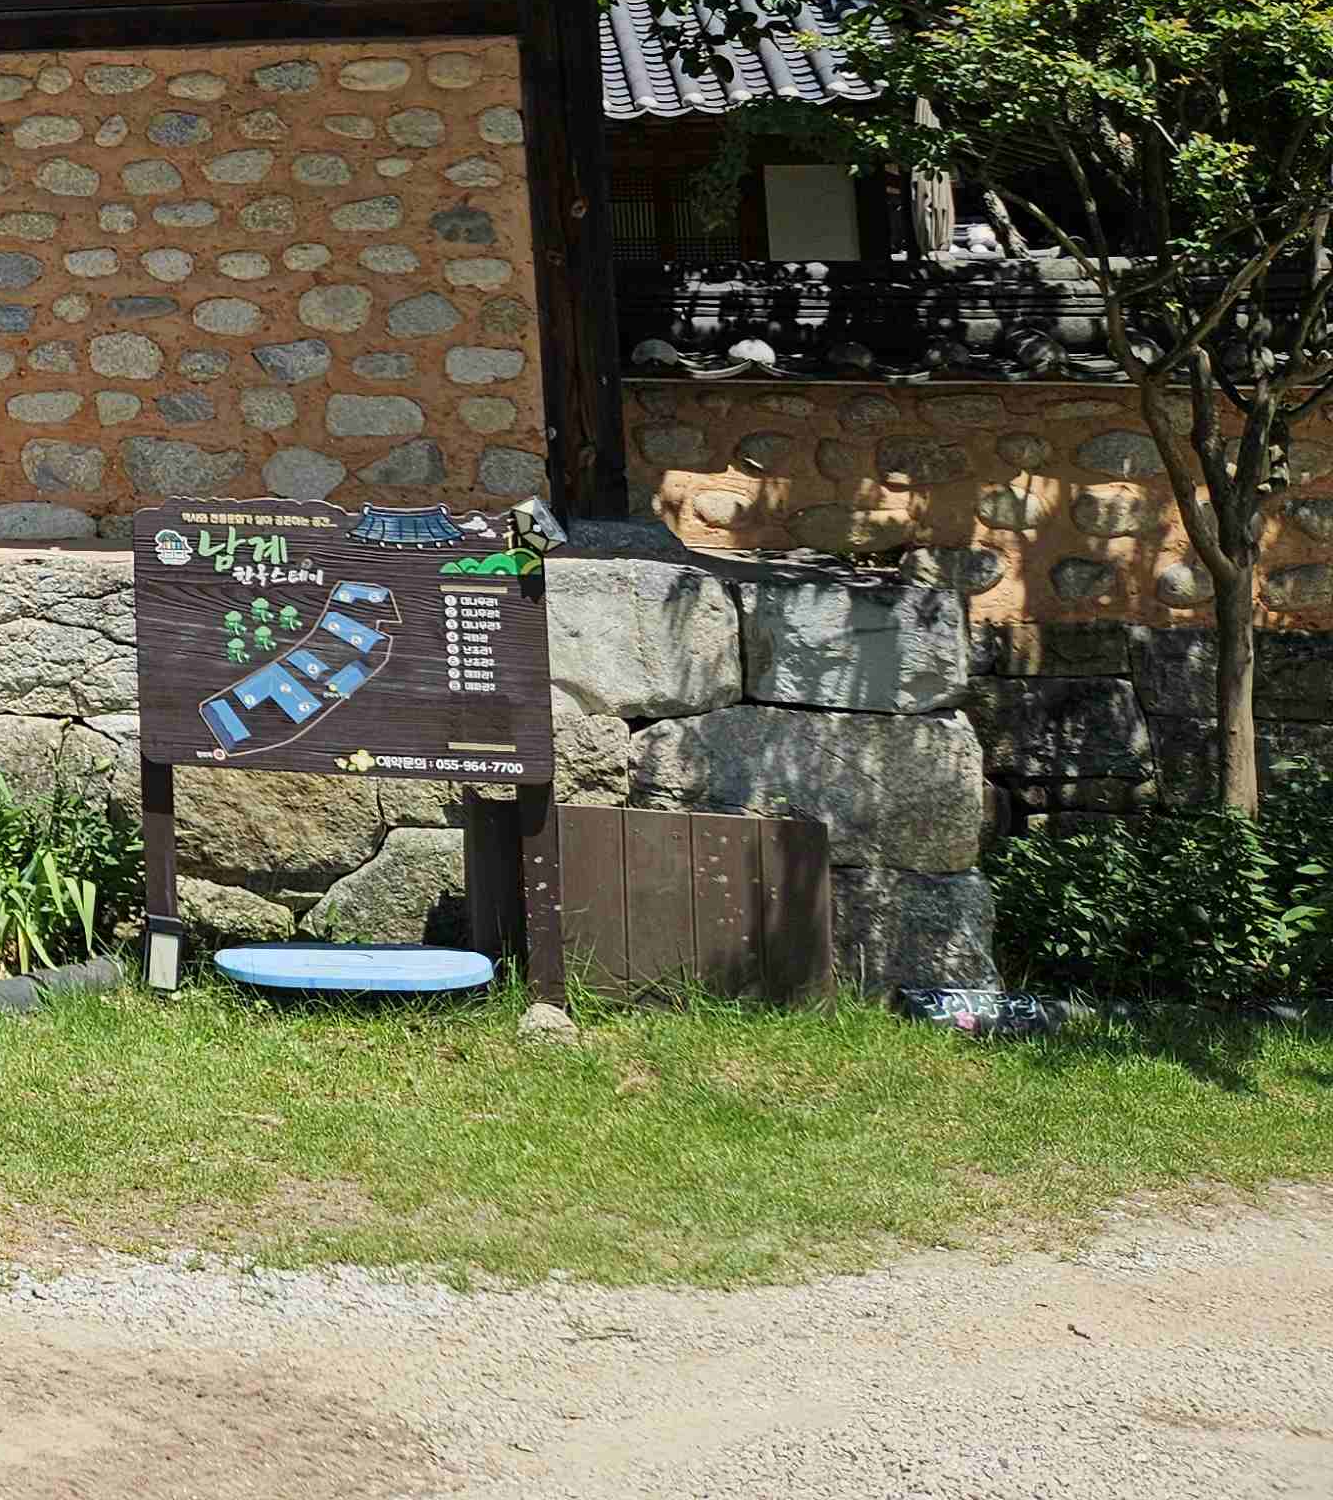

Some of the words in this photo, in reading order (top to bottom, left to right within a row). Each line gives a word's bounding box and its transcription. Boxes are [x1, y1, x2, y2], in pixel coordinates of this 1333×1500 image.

[198, 526, 288, 572] 남계
[232, 563, 324, 587] 한옥스테이
[376, 755, 426, 770] 예약문의
[436, 759, 524, 774] 055-964-7700
